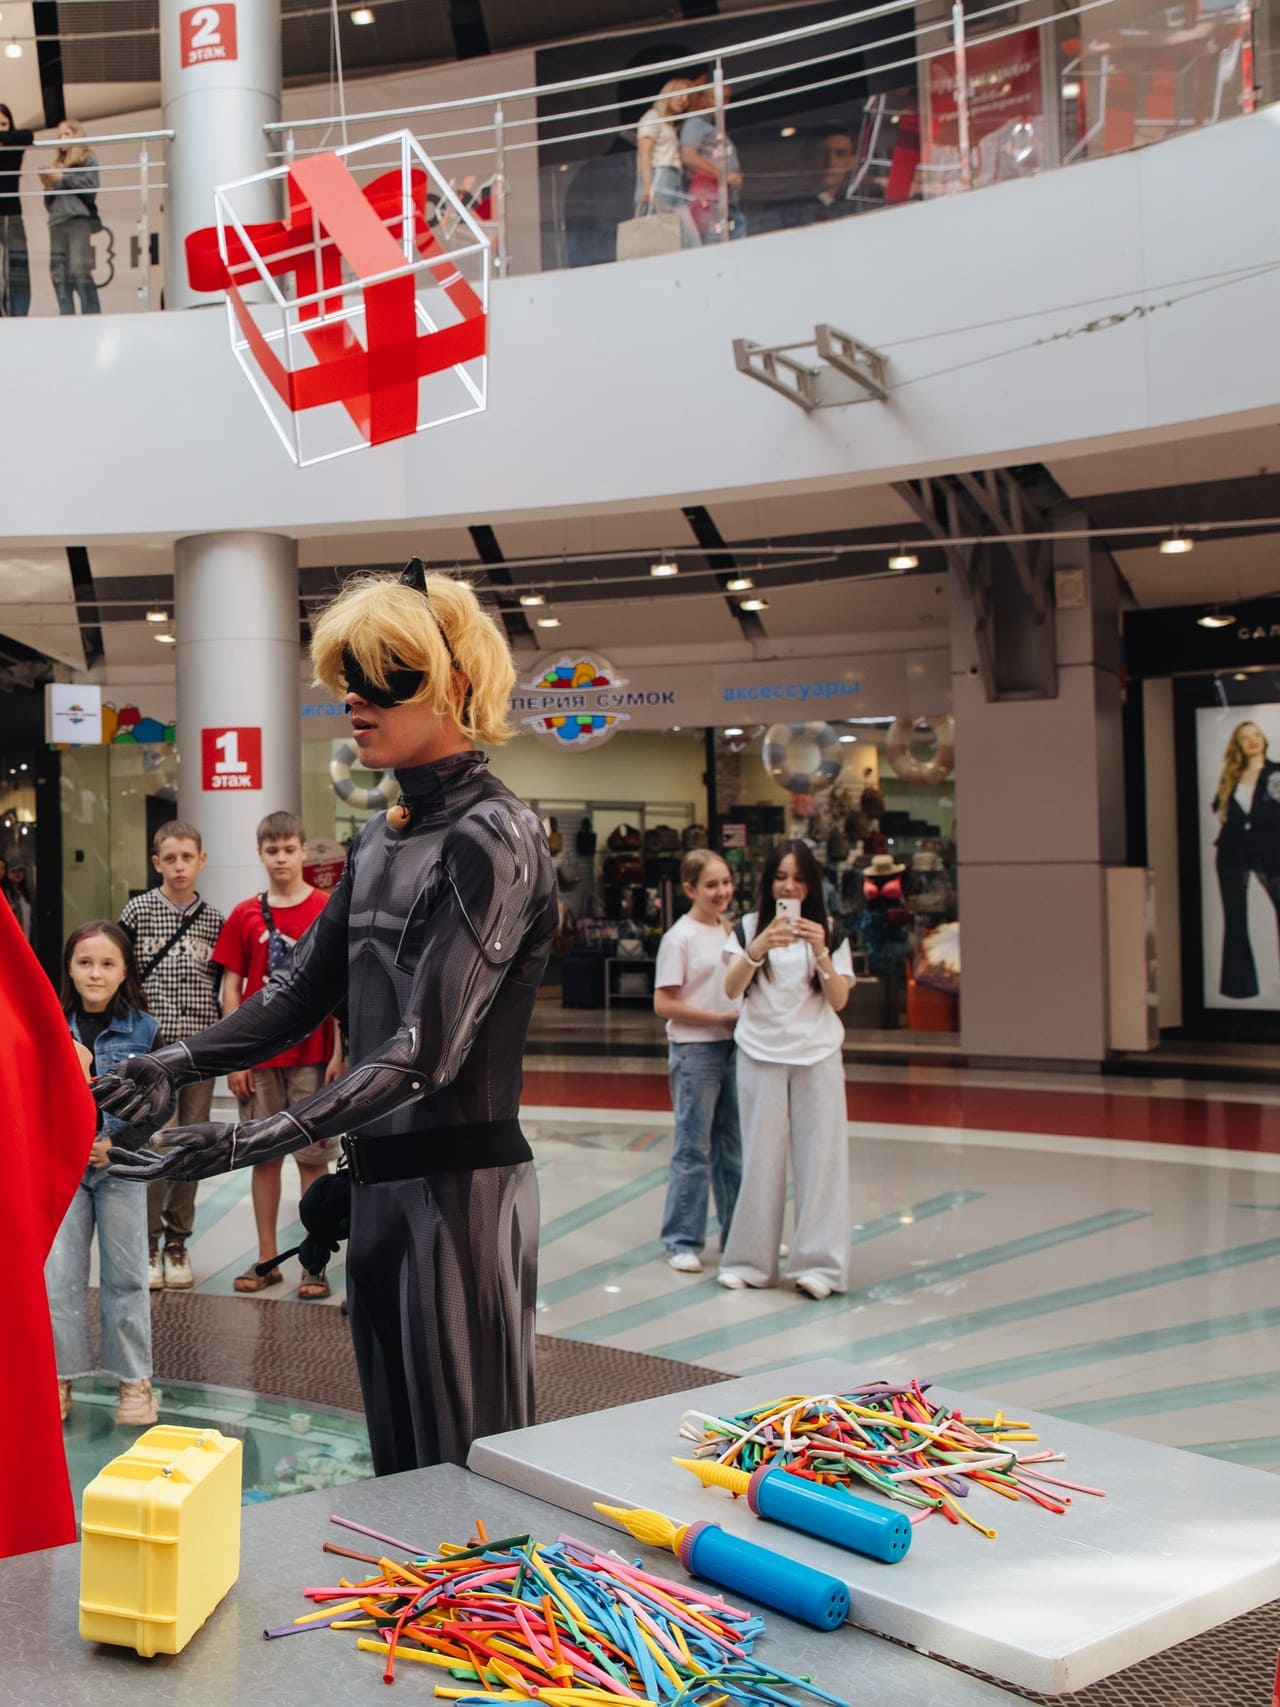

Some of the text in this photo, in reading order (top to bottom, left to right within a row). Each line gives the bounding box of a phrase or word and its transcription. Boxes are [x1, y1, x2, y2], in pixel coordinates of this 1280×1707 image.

[191, 7, 221, 49] 2
[188, 45, 226, 63] этаж
[596, 690, 675, 707] СУМОК
[723, 681, 861, 702] аксессуары
[215, 731, 248, 774] 1
[211, 775, 252, 788] этаж
